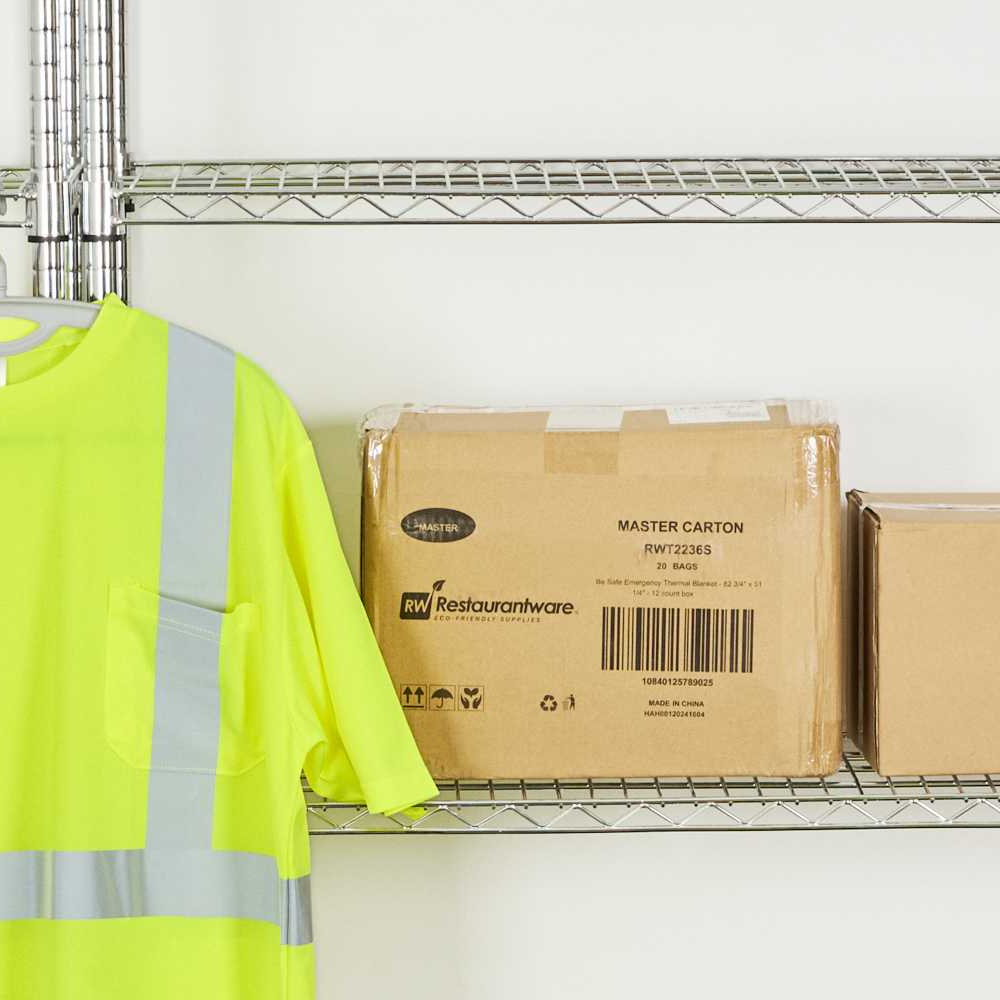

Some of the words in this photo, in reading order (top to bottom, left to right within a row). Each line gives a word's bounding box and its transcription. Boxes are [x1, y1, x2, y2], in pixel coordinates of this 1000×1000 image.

[418, 522, 458, 532] MASTER
[618, 519, 678, 532] MASTER
[682, 521, 744, 533] CARTON
[644, 543, 712, 556] RWT2236S
[656, 562, 667, 570] 20
[672, 562, 699, 570] BAGS
[404, 599, 428, 613] RW
[436, 597, 574, 615] Restaurantware
[642, 677, 714, 687] 10840125789025
[648, 699, 670, 707] MADE
[672, 699, 680, 707] IN
[682, 700, 705, 708] CHINA
